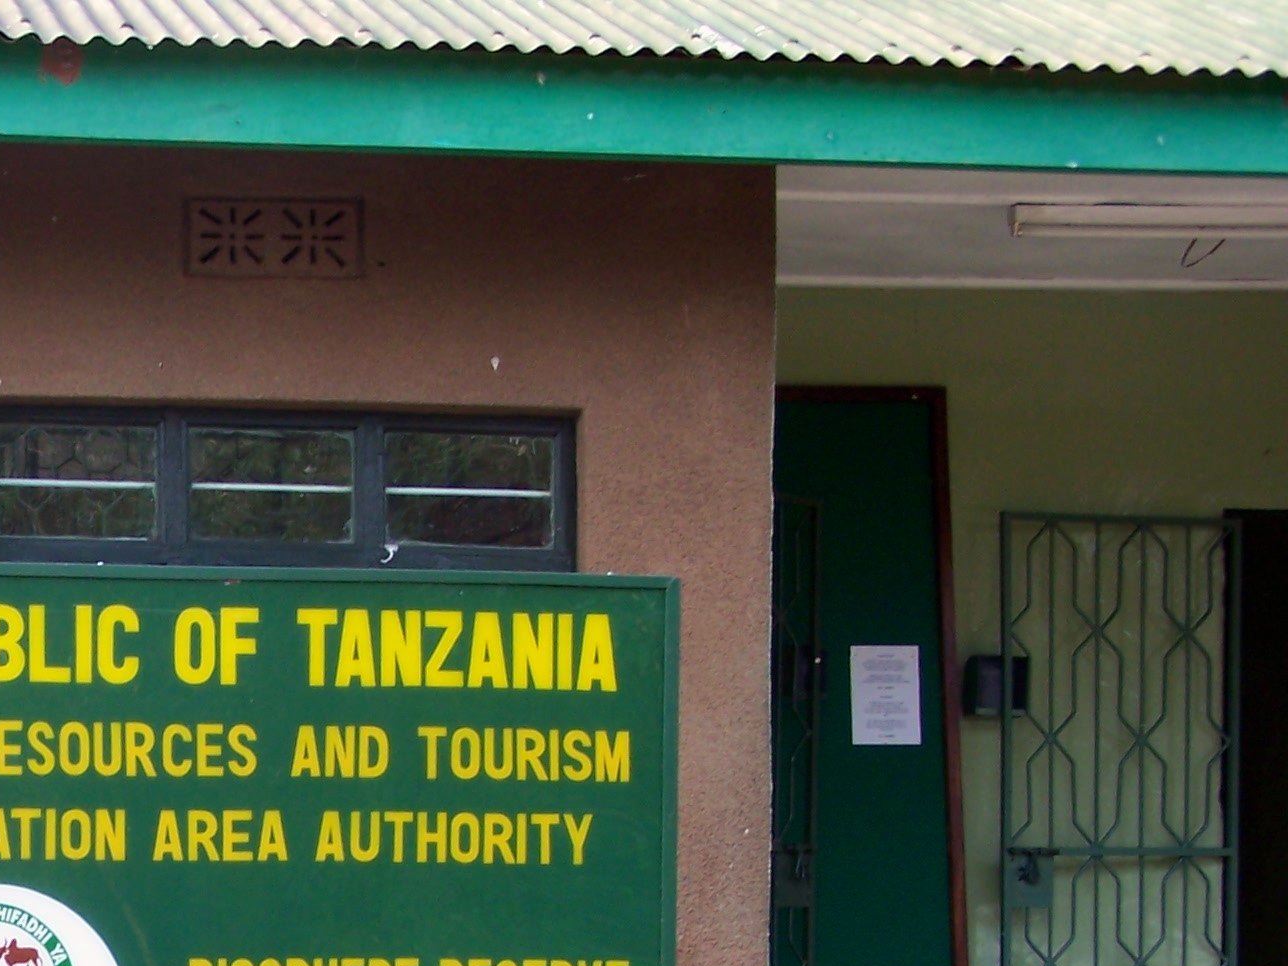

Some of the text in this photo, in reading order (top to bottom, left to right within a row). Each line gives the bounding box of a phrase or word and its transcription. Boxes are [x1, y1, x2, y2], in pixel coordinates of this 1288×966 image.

[173, 606, 260, 686] OF
[297, 607, 618, 692] TANZANIA
[291, 725, 390, 779] AND
[417, 727, 631, 782] TOURISM
[152, 809, 288, 862] AREA
[315, 811, 593, 866] AUTHORITY
[51, 939, 68, 966] YA
